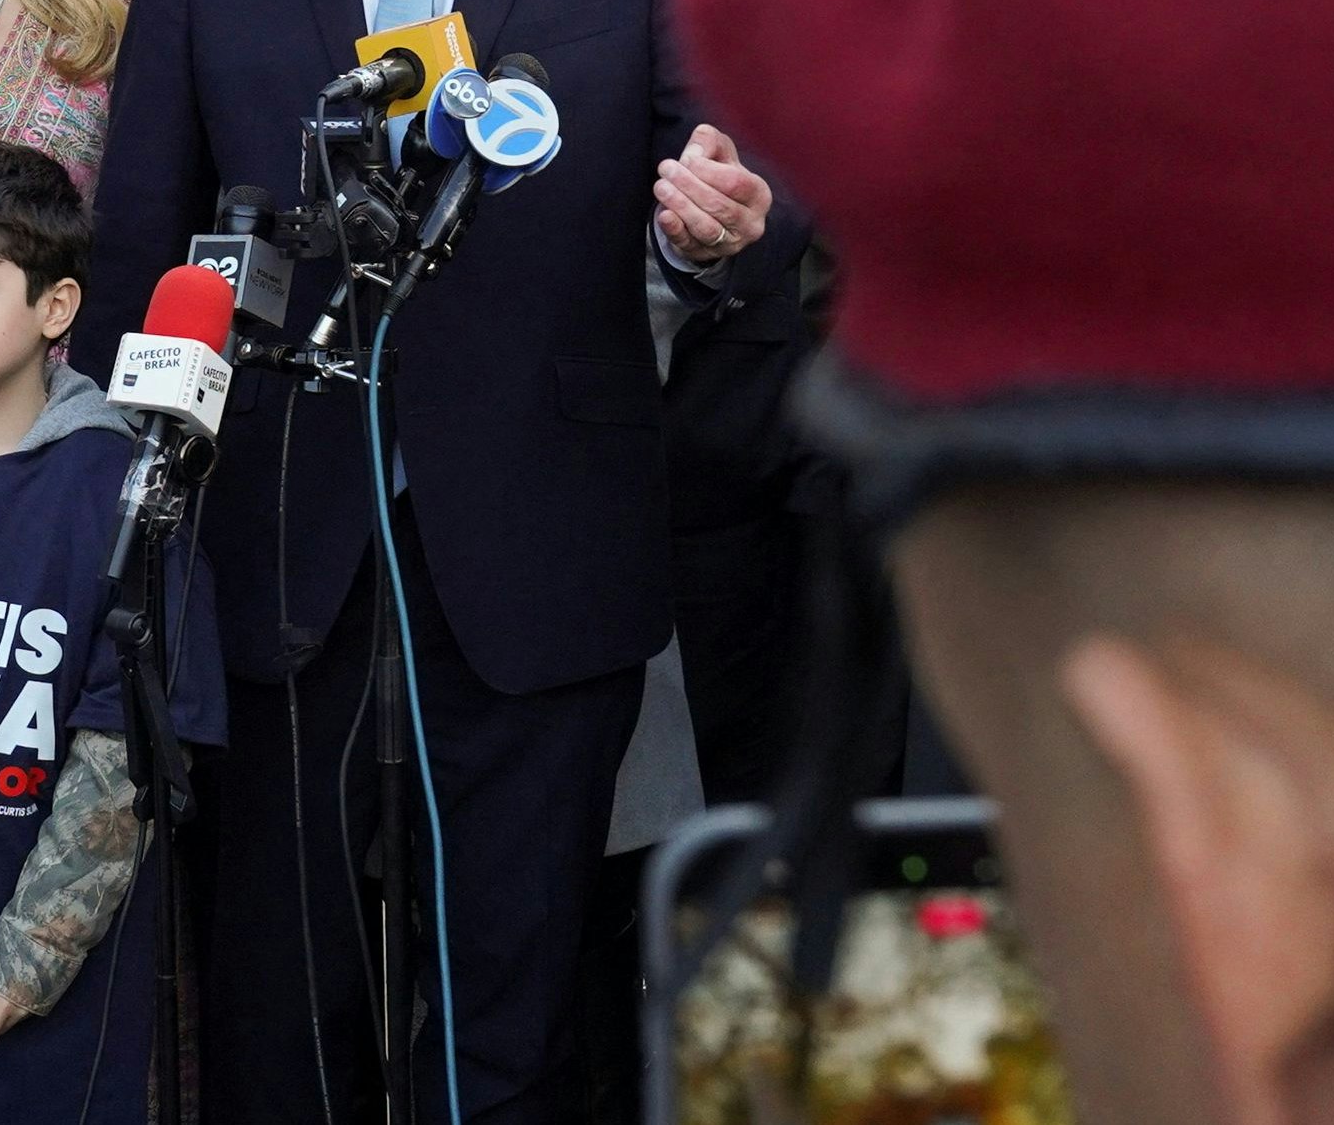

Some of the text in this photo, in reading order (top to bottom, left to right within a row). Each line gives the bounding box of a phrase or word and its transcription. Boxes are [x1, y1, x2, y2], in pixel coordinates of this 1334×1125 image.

[444, 78, 490, 112] abc
[129, 347, 181, 361] CAFECITO
[144, 358, 181, 371] BREAK
[203, 365, 228, 383] CAFECITO
[208, 380, 226, 394] BREAK
